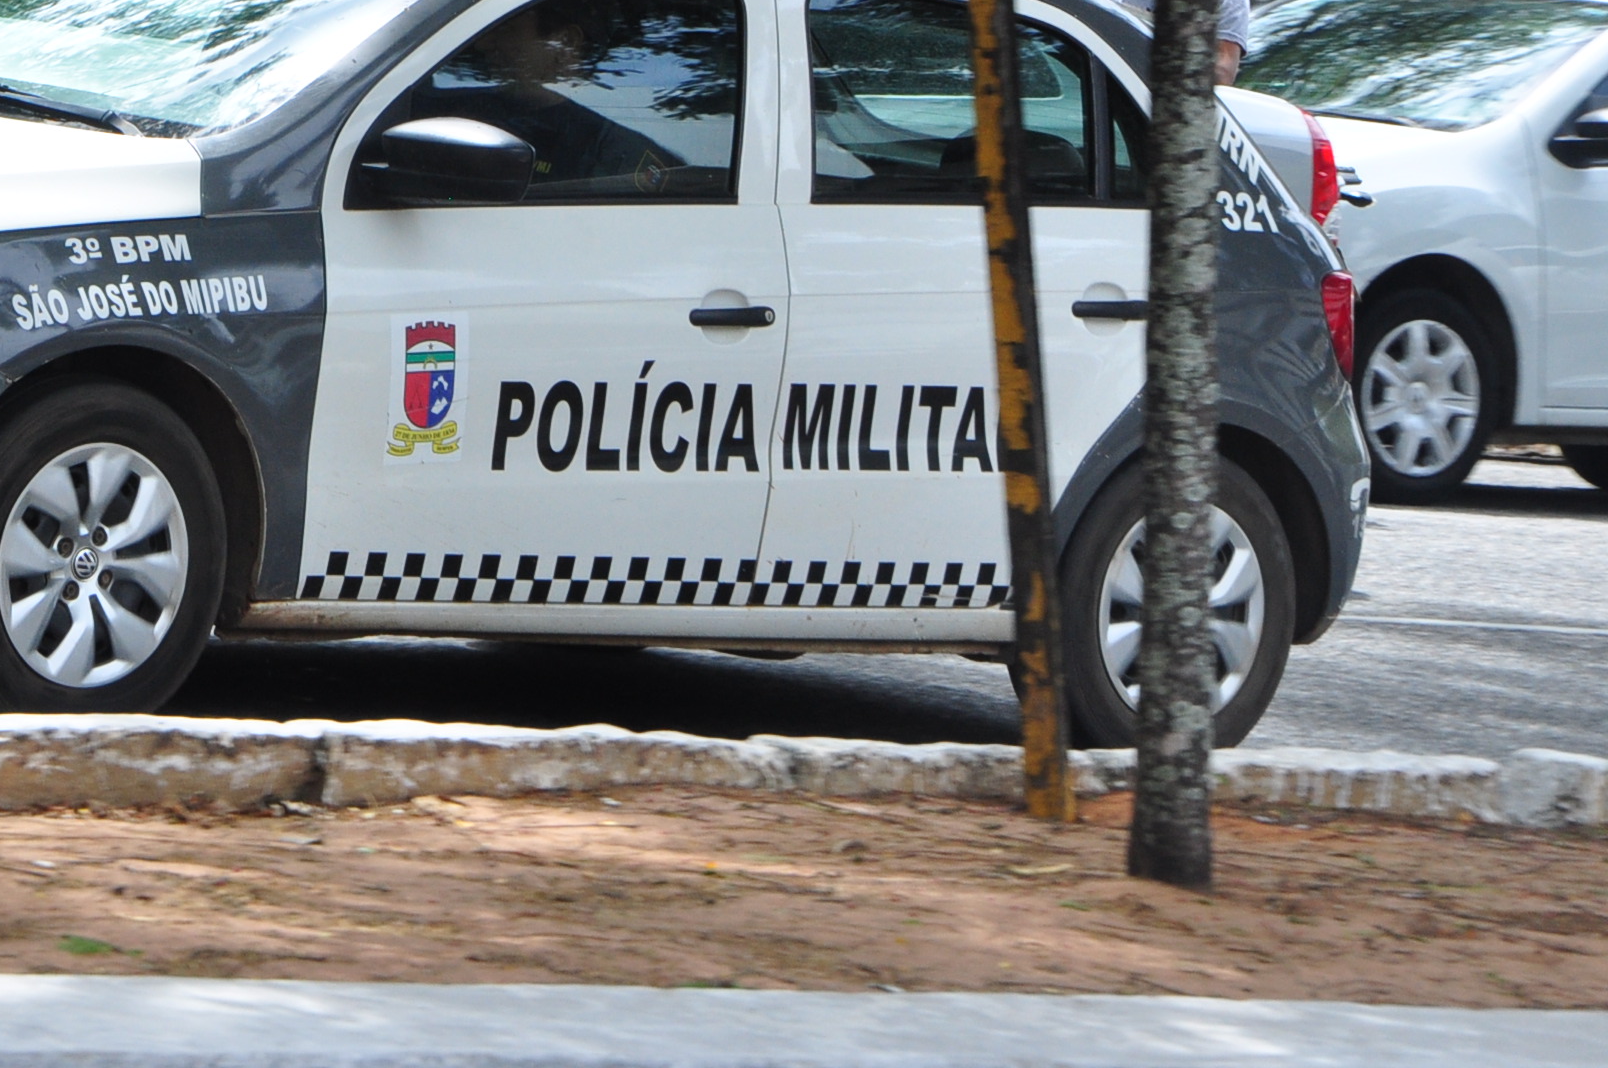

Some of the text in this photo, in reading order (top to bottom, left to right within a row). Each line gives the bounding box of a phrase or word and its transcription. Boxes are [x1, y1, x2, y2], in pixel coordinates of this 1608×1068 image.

[1215, 102, 1260, 186] RN
[1215, 190, 1281, 234] 321
[64, 233, 192, 265] 3º BPM
[12, 274, 268, 331] SÃO JOSÉ DO MIPIBU
[491, 360, 1002, 473] POLÍCIA MILITA
